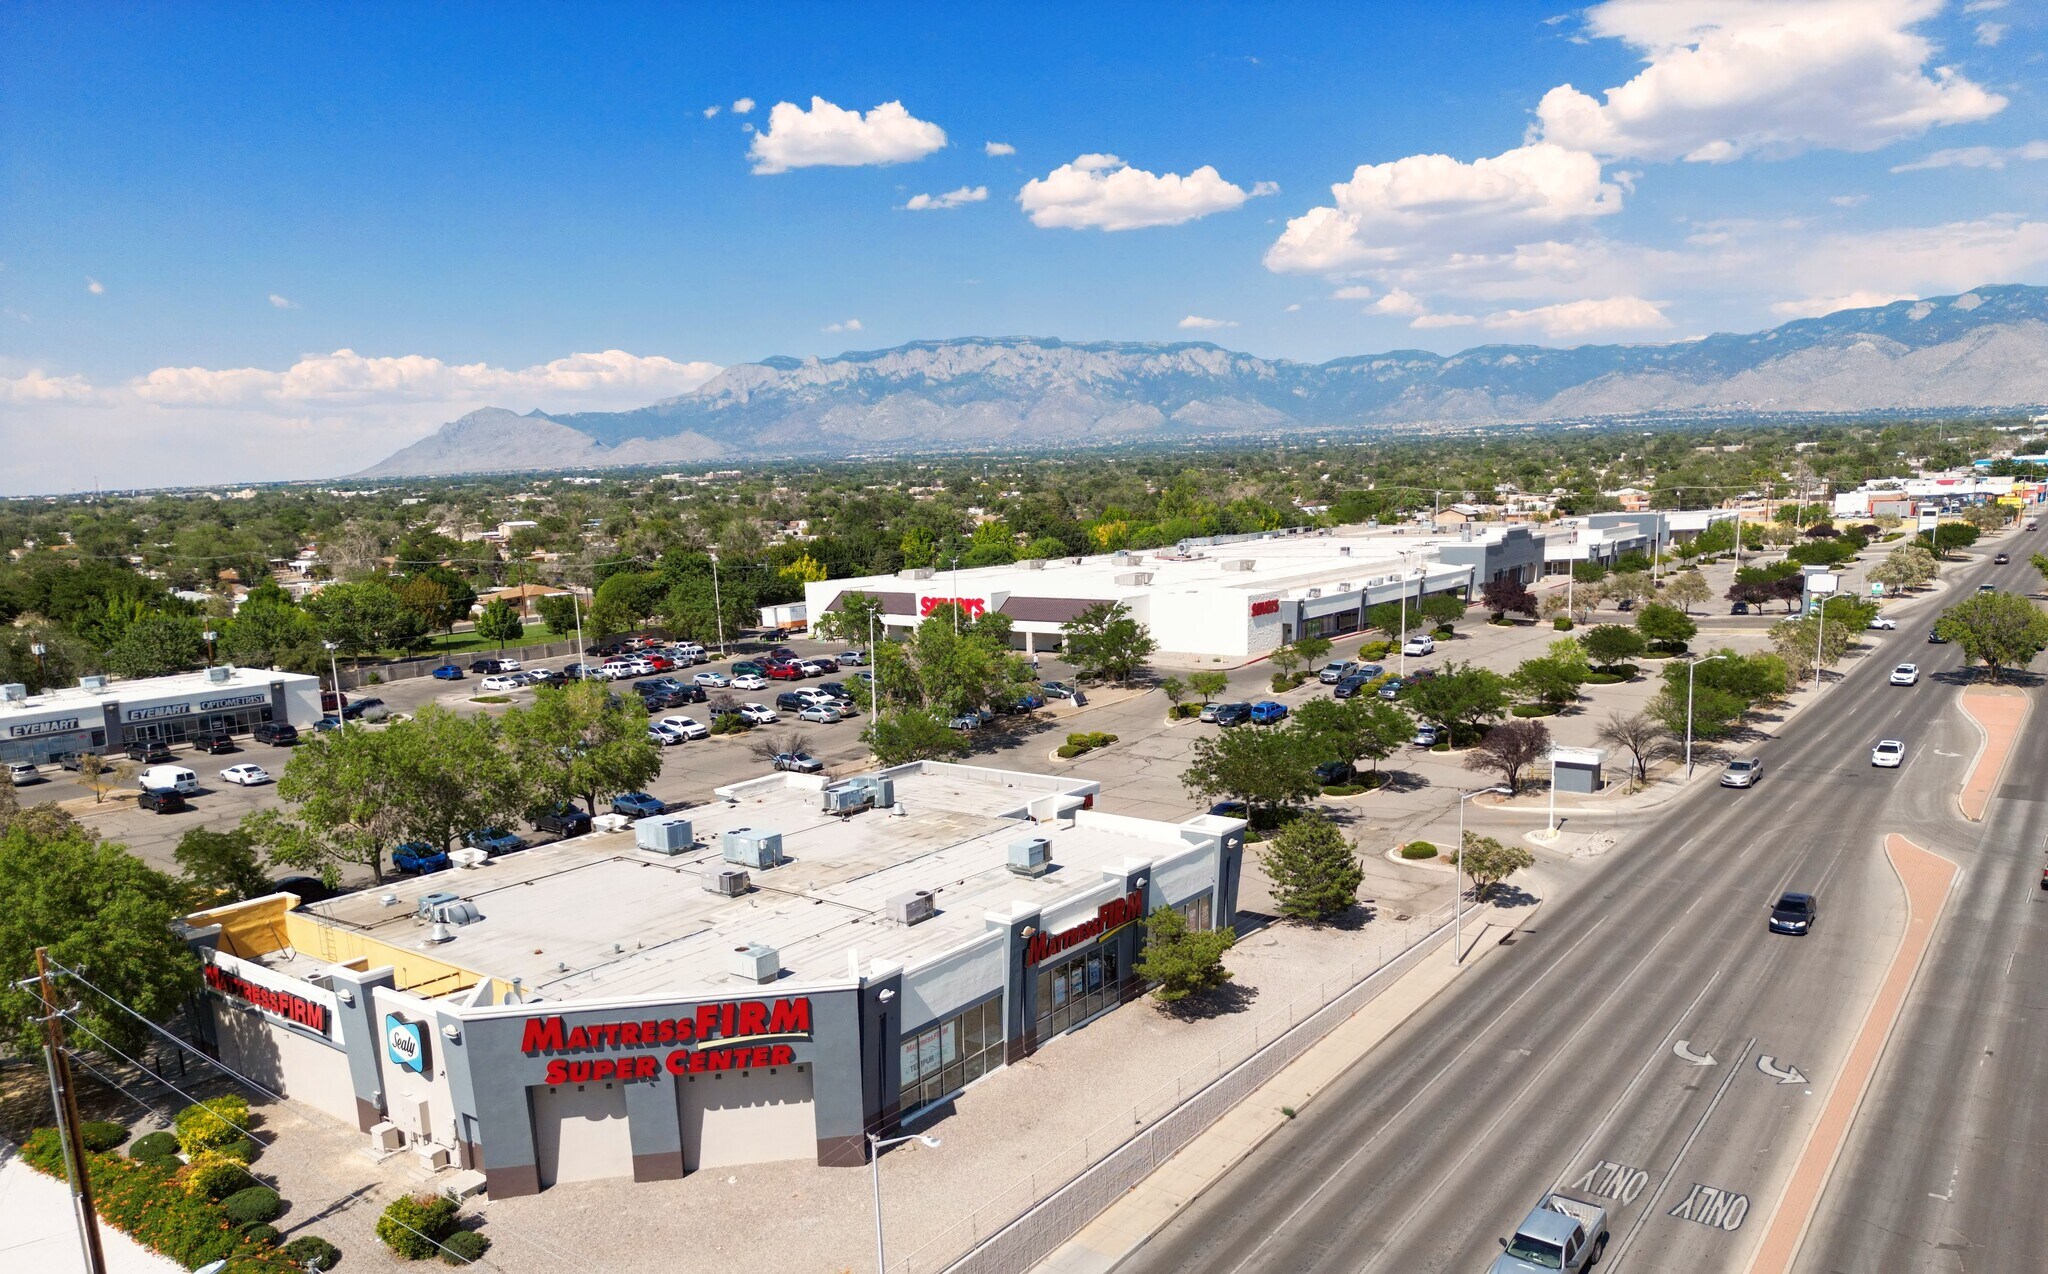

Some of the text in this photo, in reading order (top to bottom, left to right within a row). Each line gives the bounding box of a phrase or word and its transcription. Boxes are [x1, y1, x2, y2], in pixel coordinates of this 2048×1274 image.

[130, 703, 190, 721] EYEMART
[201, 694, 265, 710] OPTOMETRIST
[12, 718, 78, 737] EYEMART
[391, 1031, 416, 1057] Sealy
[543, 1044, 794, 1086] SUPER CENTER
[1570, 1160, 1650, 1206] ONLY
[1669, 1184, 1750, 1232] ONLY
